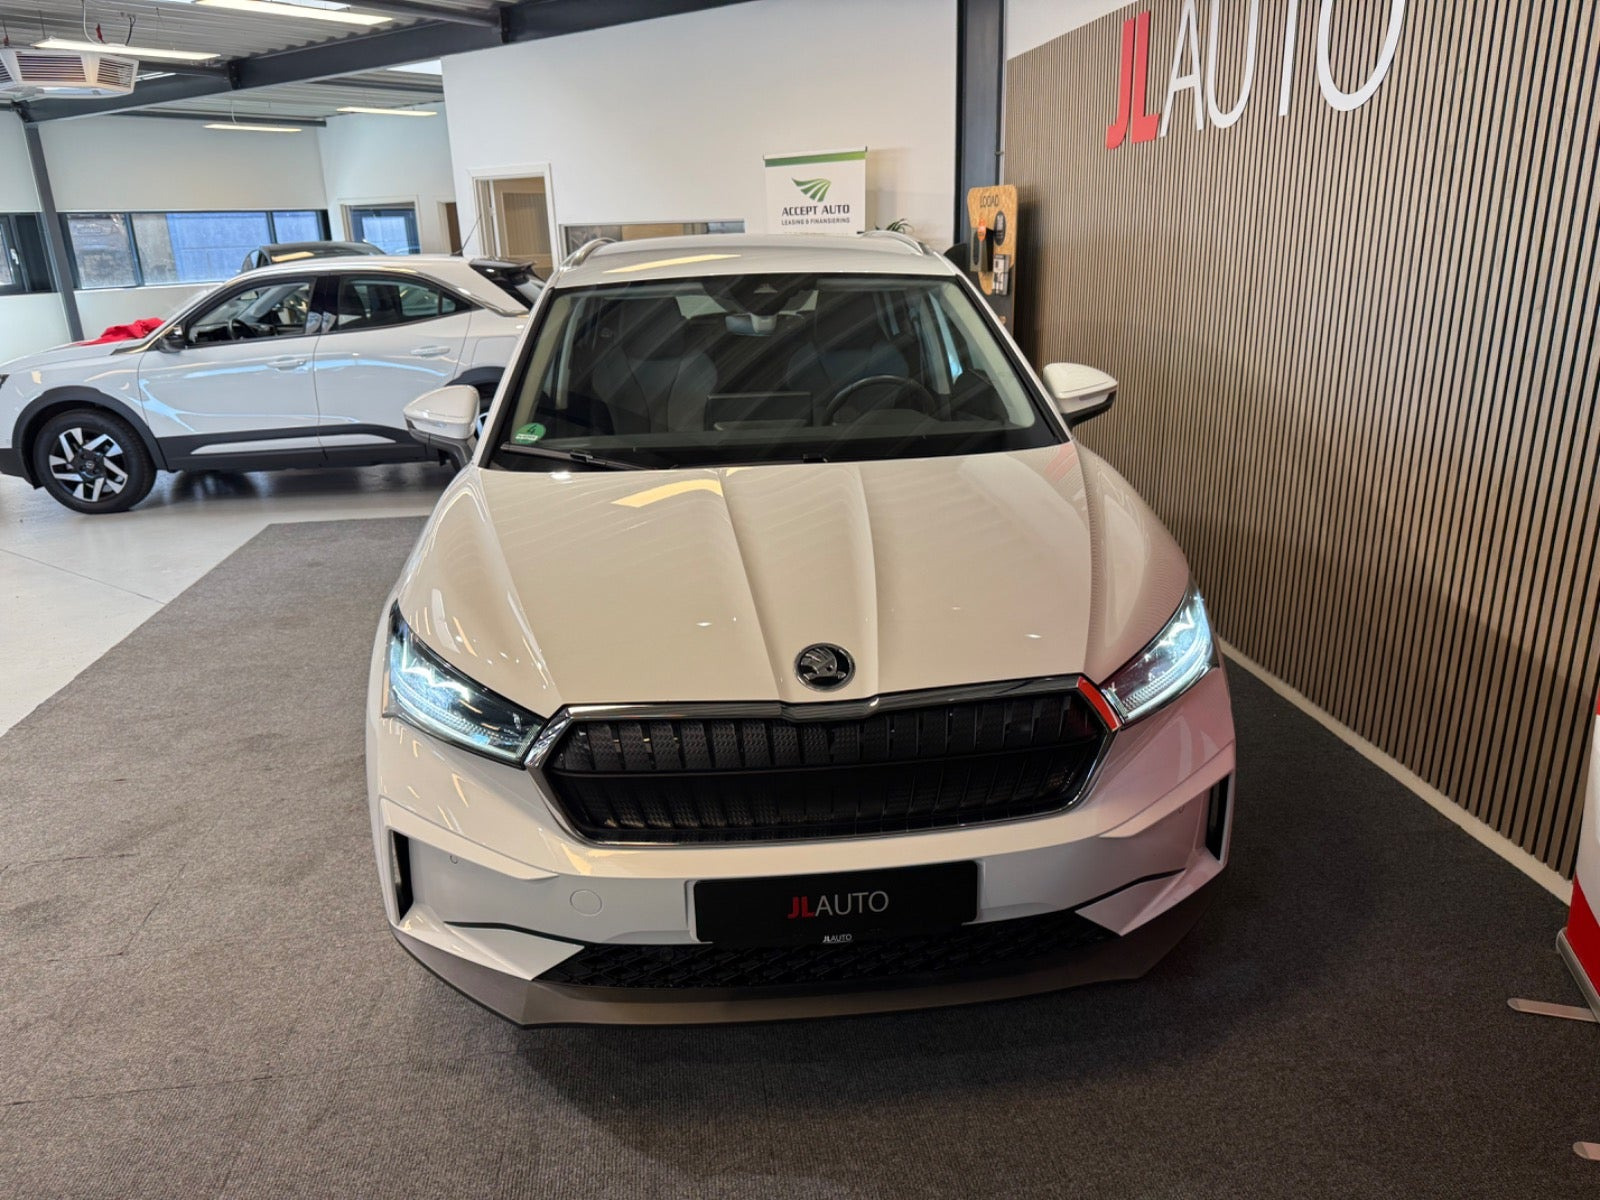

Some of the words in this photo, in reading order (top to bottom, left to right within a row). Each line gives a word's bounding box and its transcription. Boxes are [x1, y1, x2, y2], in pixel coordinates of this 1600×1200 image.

[781, 205, 818, 217] ACCEPT
[821, 204, 850, 215] AUTO
[527, 424, 537, 434] 4
[787, 890, 889, 919] JLAUTO
[822, 933, 853, 944] JLAUTO
